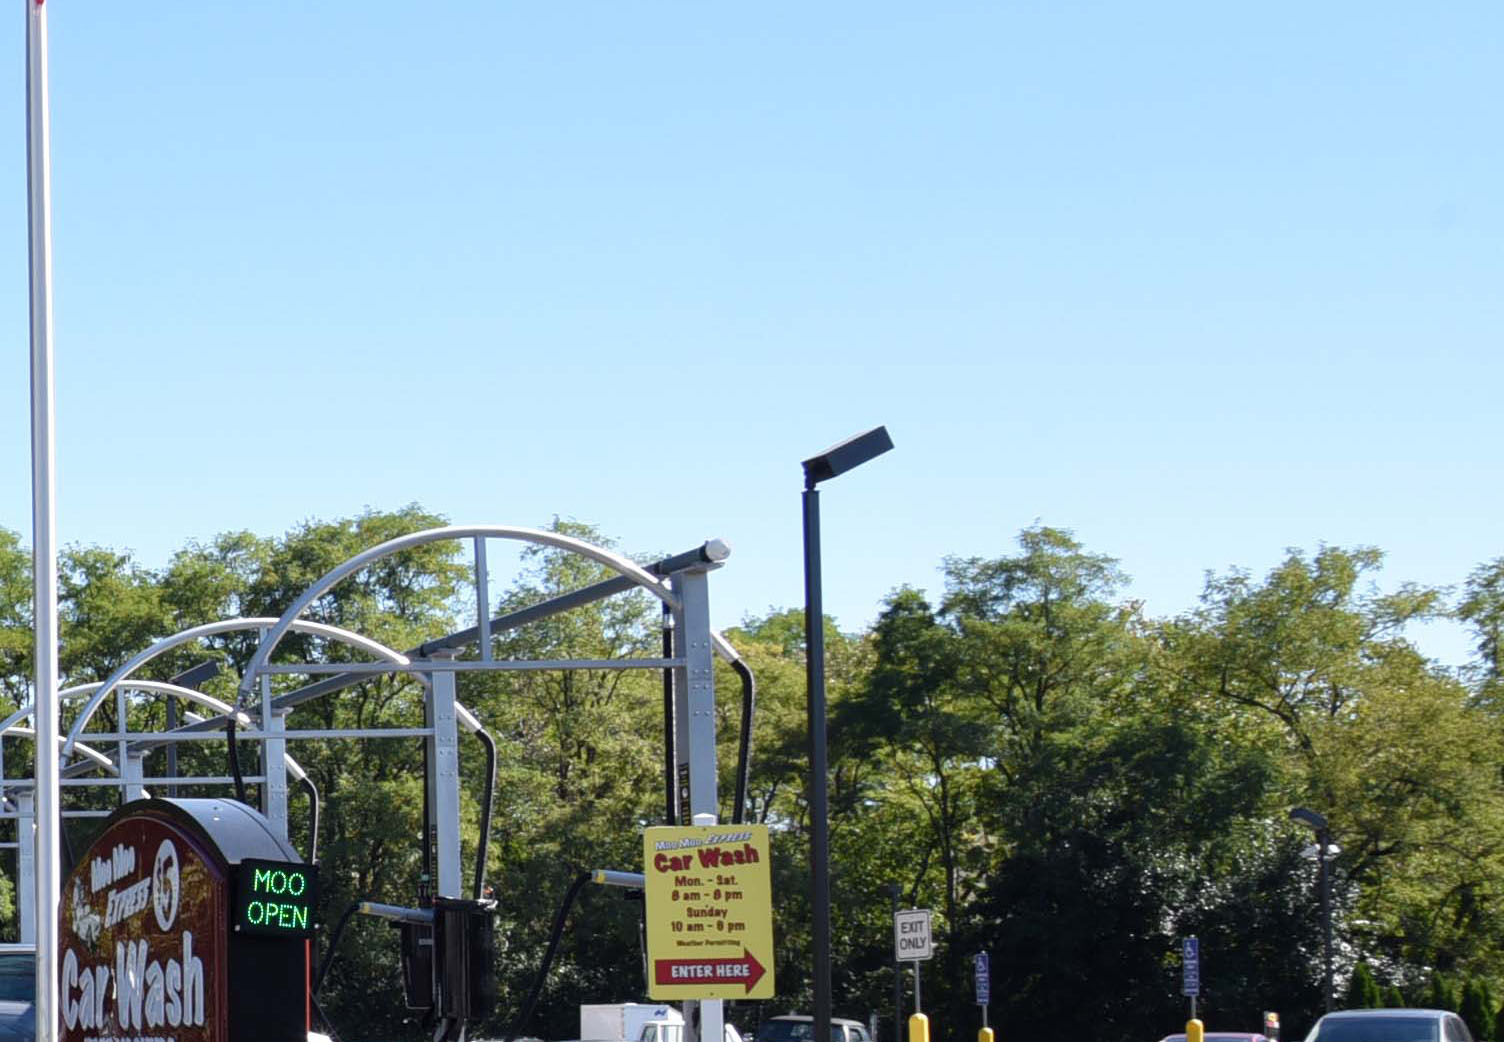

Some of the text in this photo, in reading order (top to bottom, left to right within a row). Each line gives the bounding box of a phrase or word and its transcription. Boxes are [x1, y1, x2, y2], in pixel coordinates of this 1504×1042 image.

[654, 843, 760, 873] Car Wash
[253, 868, 305, 896] MOO
[674, 876, 704, 887] Mon.
[716, 874, 739, 886] Sat.
[683, 892, 701, 901] am
[725, 890, 743, 902] pm
[247, 901, 308, 930] OPEN
[686, 906, 728, 919] Sunday
[671, 920, 684, 932] 10
[686, 922, 705, 932] am
[727, 922, 746, 933] pm
[900, 920, 924, 934] EXIT
[899, 937, 927, 951] ONLY
[671, 963, 751, 978] ENTER HERE
[61, 929, 205, 1032] Car Wash
